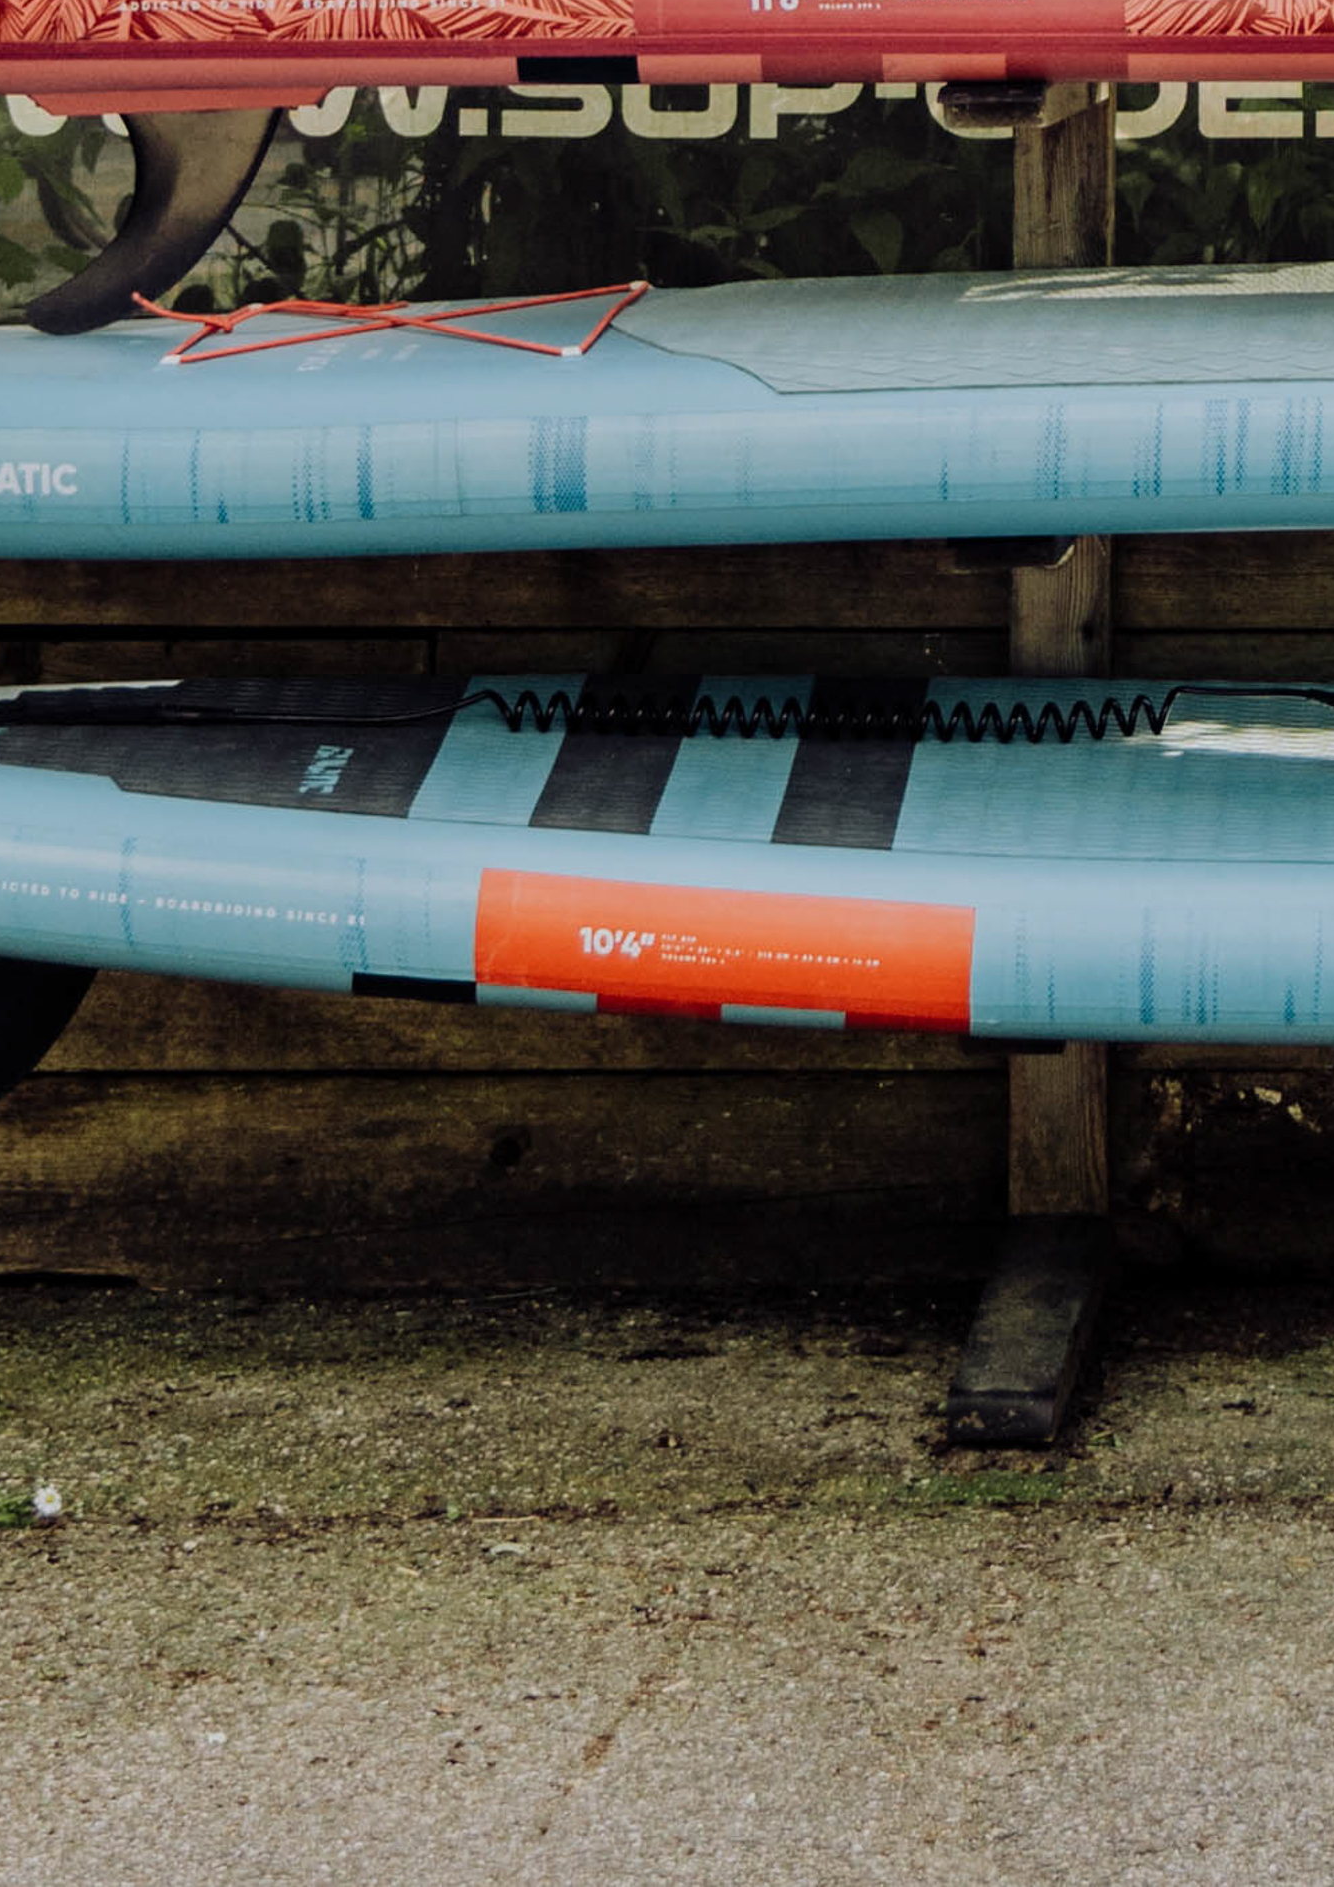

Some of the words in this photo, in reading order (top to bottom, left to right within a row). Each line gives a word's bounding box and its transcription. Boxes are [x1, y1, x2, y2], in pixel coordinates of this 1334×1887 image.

[59, 887, 80, 900] TO
[88, 890, 129, 905] RIDE
[579, 926, 656, 958] 10'4"
